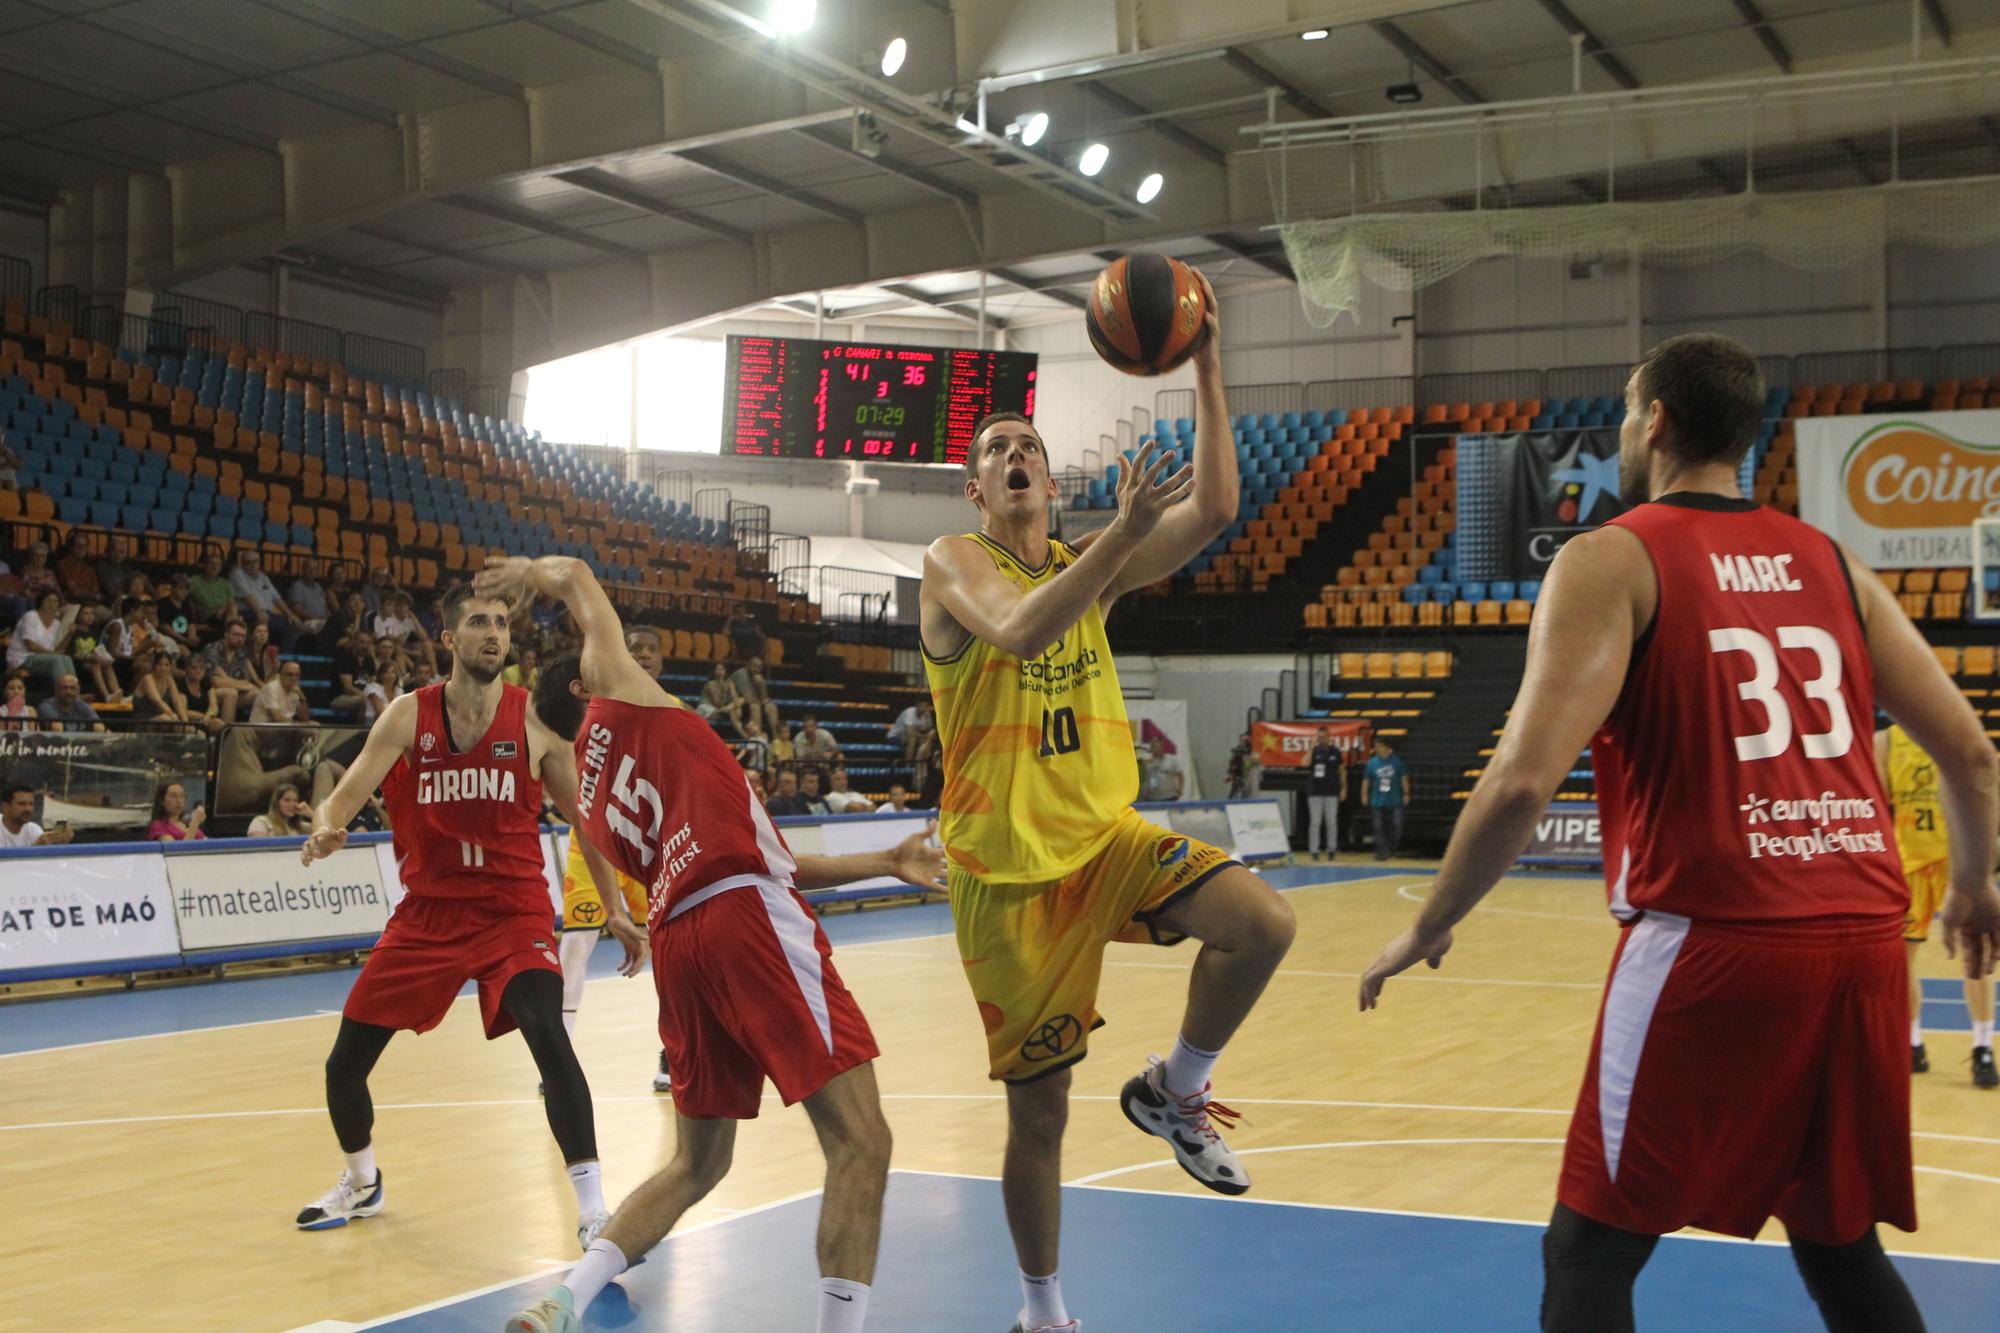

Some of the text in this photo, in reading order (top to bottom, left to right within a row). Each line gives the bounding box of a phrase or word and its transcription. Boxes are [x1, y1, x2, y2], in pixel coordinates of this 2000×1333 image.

[846, 363, 870, 381] 41
[877, 381, 888, 398] 3
[903, 365, 925, 385] 36
[856, 405, 905, 425] 07:29
[1709, 552, 1803, 592] MARC
[1708, 625, 1853, 762] 33
[1040, 705, 1080, 757] 10
[417, 767, 515, 804] GIRONA
[577, 723, 612, 820] MOLINS
[605, 753, 664, 867] 15
[1771, 790, 1876, 826] eurofirms
[1915, 808, 1935, 831] 21
[461, 841, 484, 867] 11
[669, 840, 702, 878] first
[1, 894, 156, 932] AT DE MAÓ
[180, 880, 379, 918] #matealestigma
